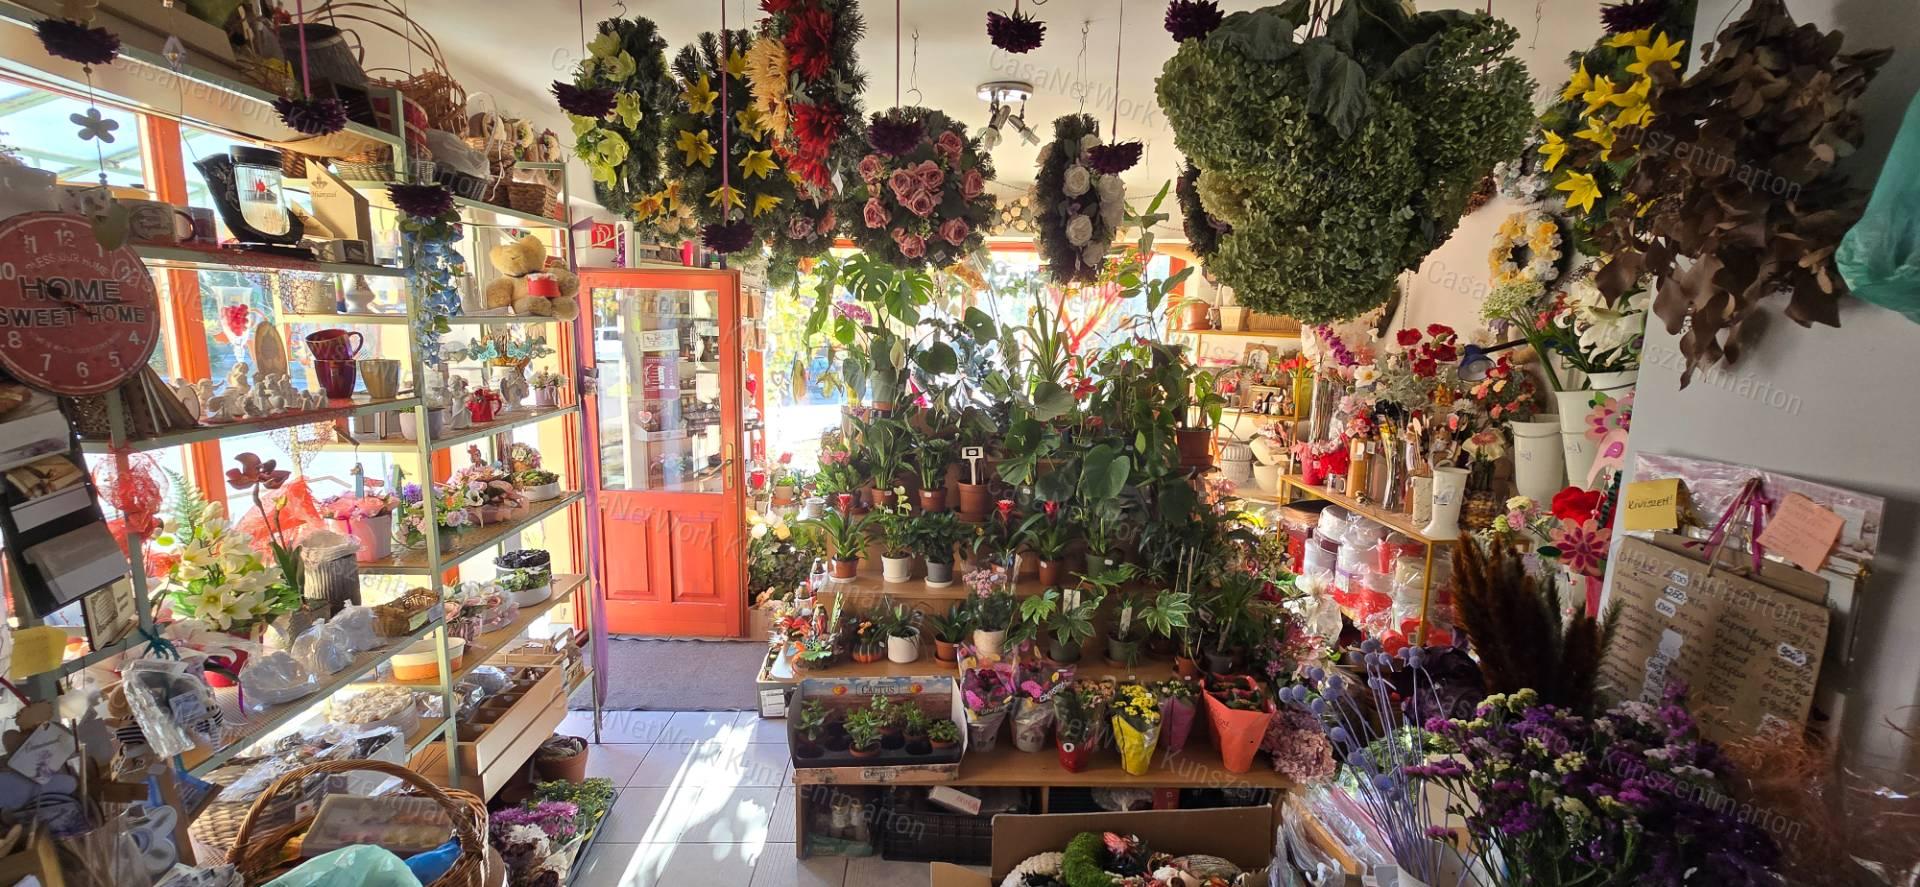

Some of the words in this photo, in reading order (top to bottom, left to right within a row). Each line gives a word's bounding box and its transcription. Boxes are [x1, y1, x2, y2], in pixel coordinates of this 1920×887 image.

[54, 229, 76, 248] 12
[17, 274, 121, 302] HOME
[0, 305, 77, 329] SWEET
[86, 304, 146, 325] HOME
[7, 330, 23, 349] 8
[128, 330, 140, 346] 4
[40, 353, 52, 372] 7
[108, 351, 121, 368] 5
[76, 361, 90, 379] 6
